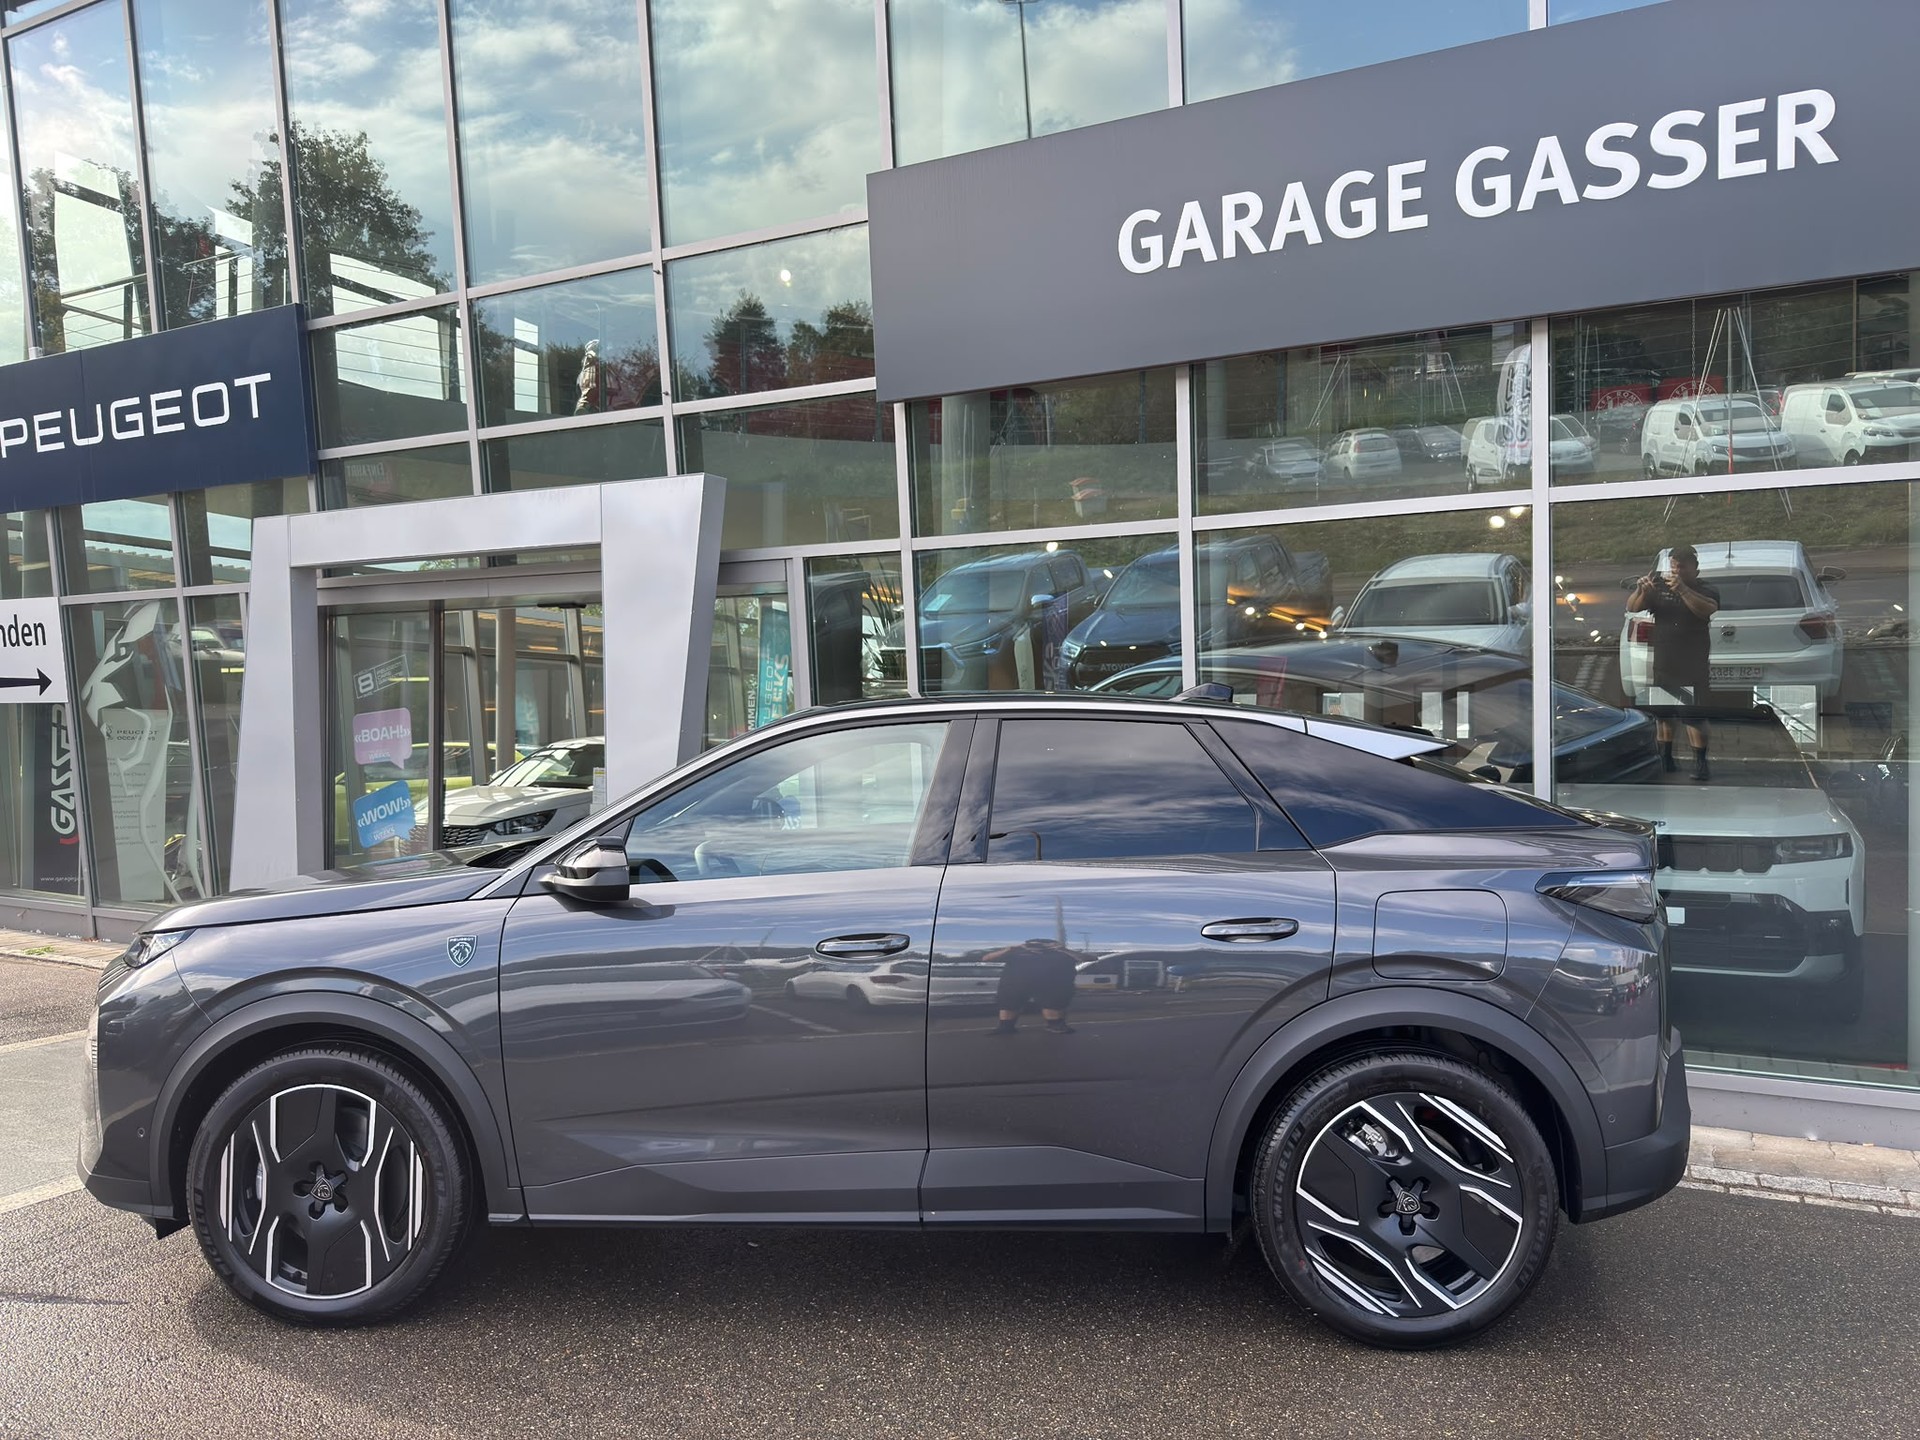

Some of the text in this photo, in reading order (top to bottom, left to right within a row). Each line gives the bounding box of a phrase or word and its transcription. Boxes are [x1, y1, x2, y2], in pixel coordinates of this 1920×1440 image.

[1117, 88, 1840, 275] GARAGE GASSER
[0, 372, 271, 458] PEUGEOT
[358, 672, 374, 693] 8
[1273, 1127, 1303, 1219] MICHELIN
